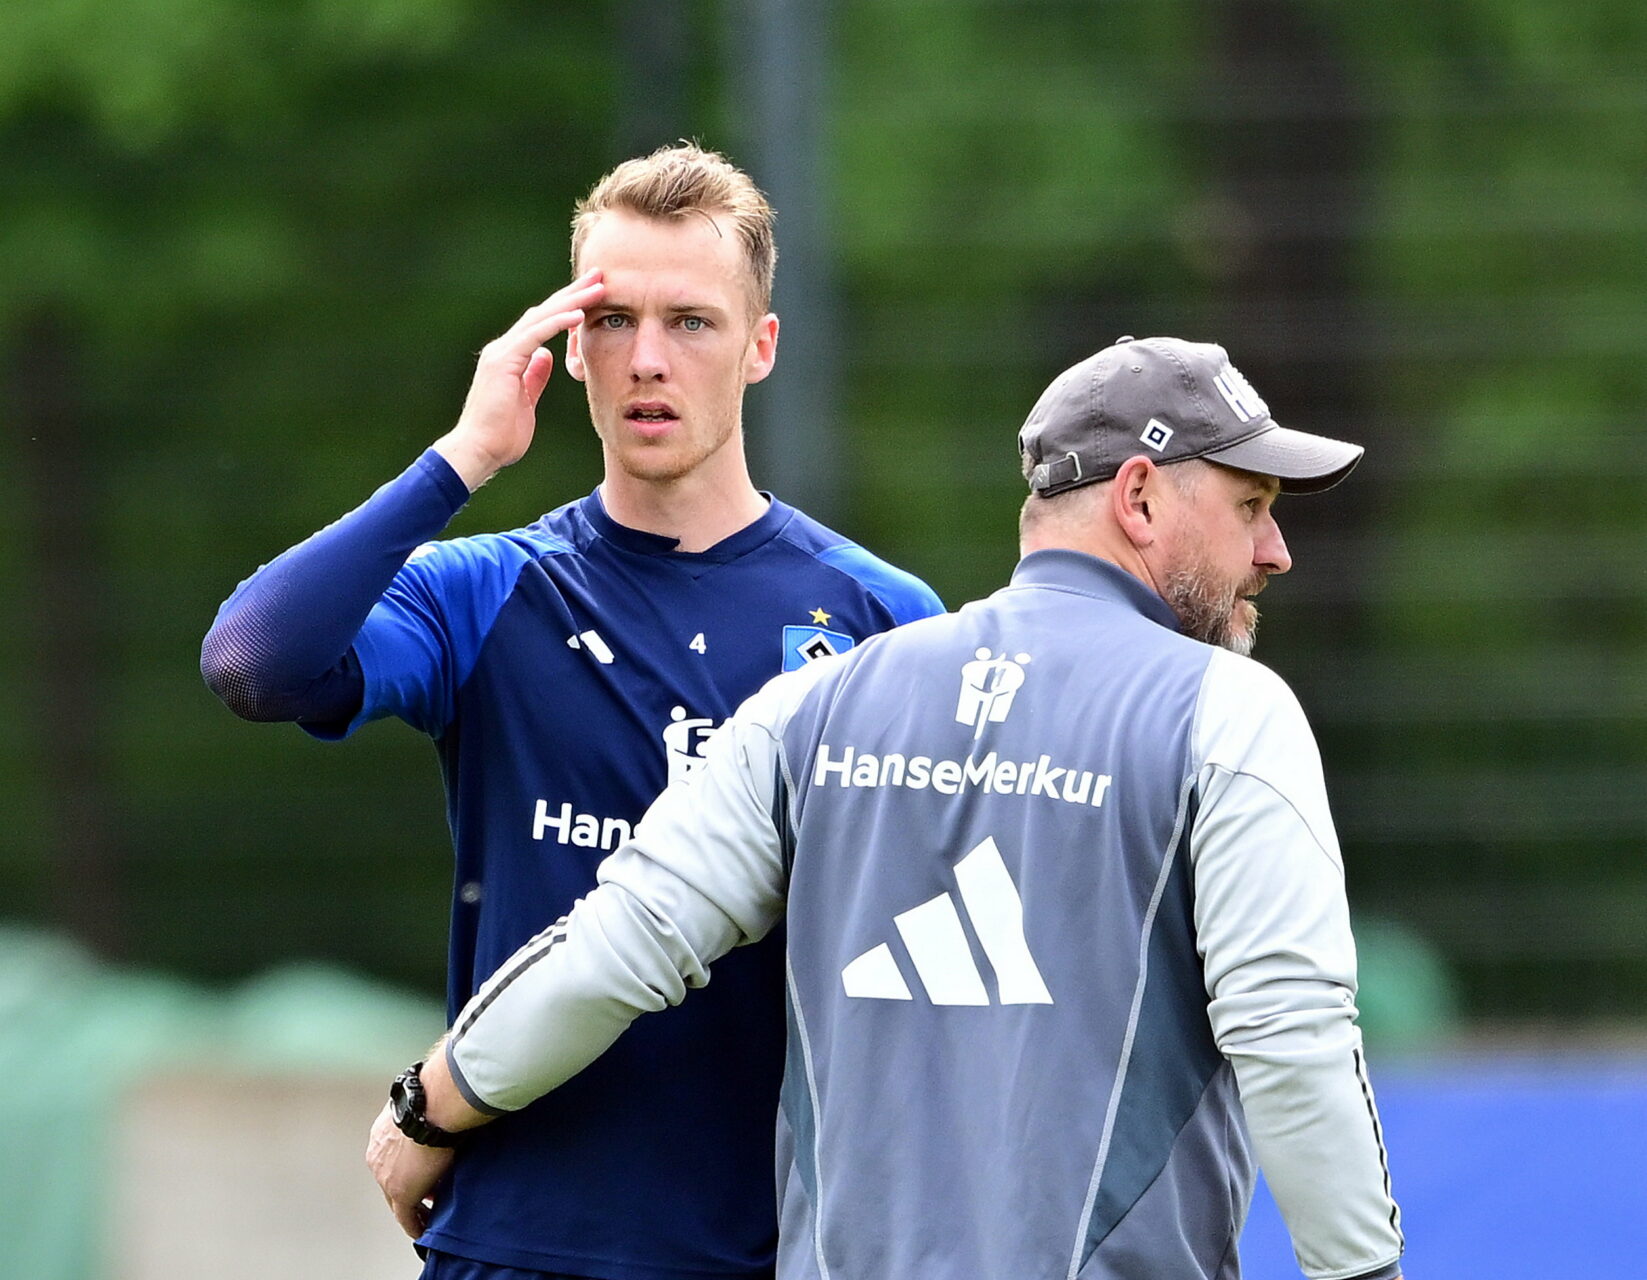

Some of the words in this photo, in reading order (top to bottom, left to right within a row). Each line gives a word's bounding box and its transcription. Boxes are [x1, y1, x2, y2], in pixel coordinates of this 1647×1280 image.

[689, 632, 707, 655] 4
[814, 744, 1112, 808] HanseMerkur
[532, 798, 642, 850] Han
